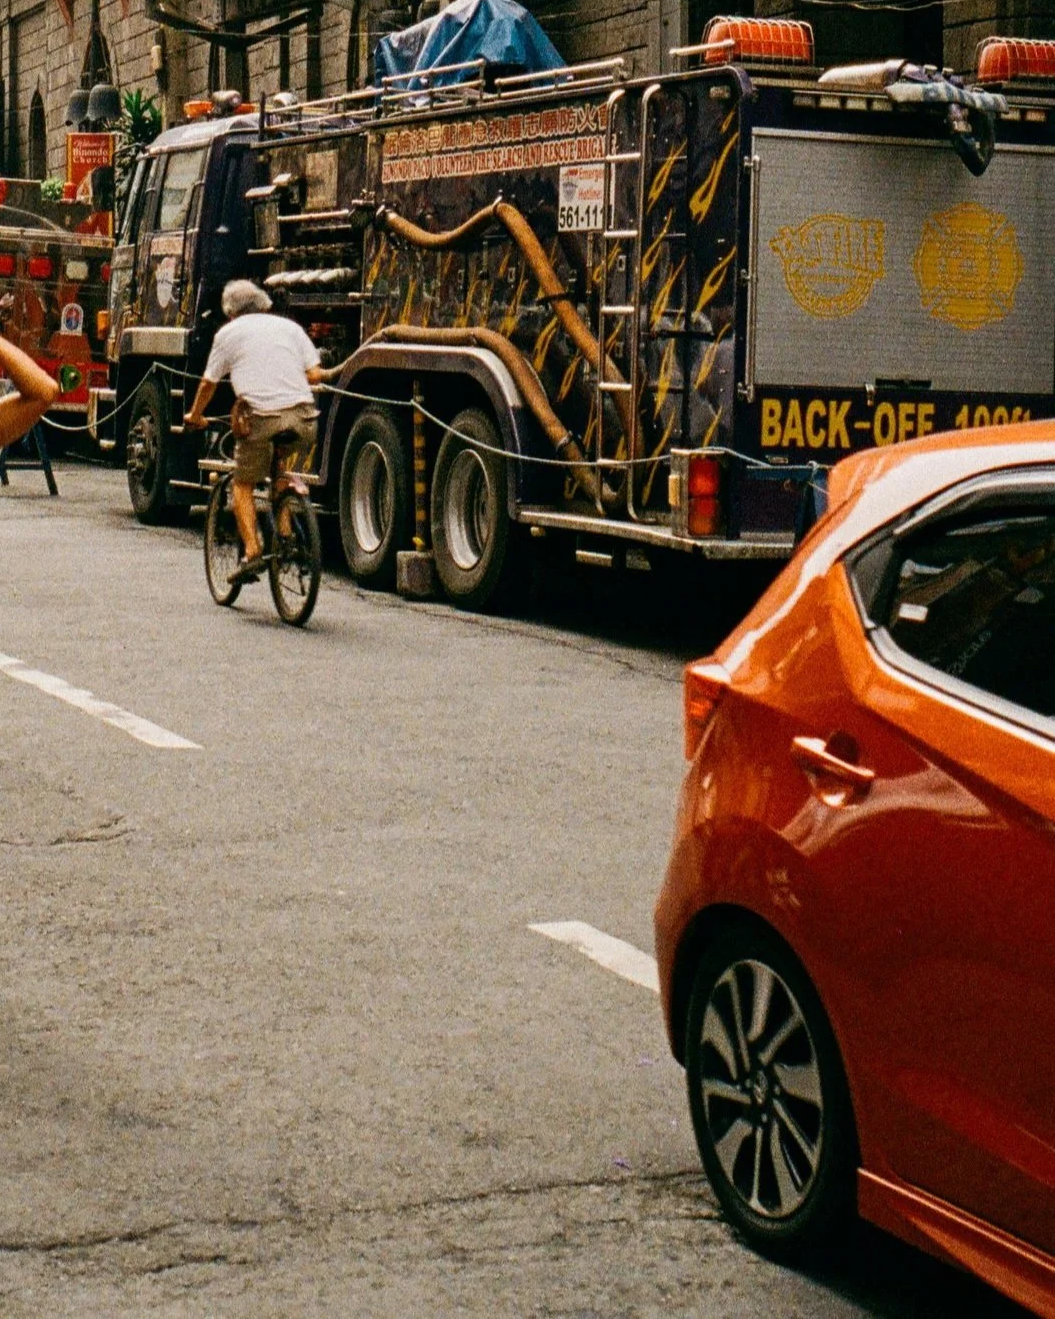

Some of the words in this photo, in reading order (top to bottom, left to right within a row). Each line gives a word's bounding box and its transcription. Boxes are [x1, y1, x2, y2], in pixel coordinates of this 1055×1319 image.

[73, 148, 108, 156] Binondo
[492, 145, 524, 170] SEARCH
[524, 143, 542, 167] AND
[543, 139, 576, 165] RESCUE
[760, 398, 935, 449] BACK-OFF
